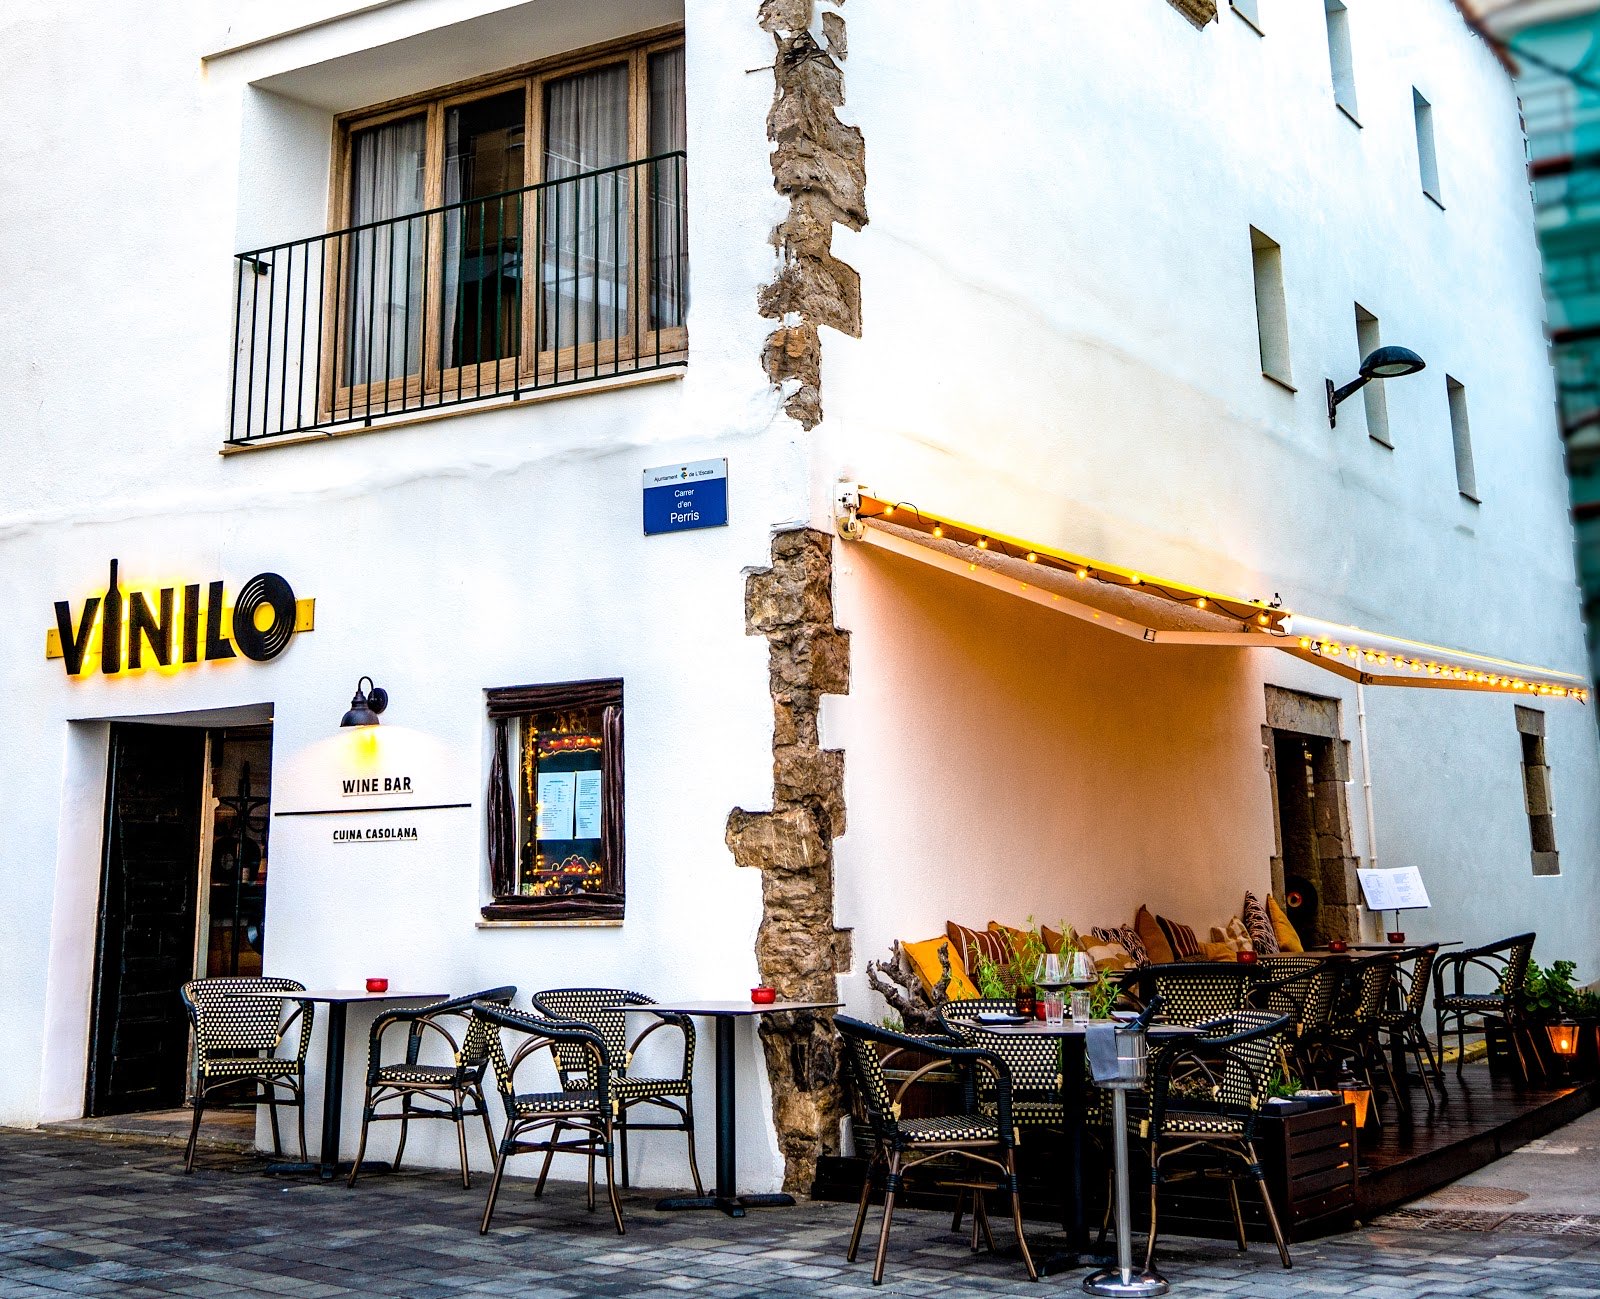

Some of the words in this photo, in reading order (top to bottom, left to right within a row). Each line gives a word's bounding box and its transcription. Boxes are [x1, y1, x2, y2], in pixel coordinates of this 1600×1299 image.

[654, 474, 678, 483] Ajuntament
[674, 489, 695, 498] Carrer
[677, 500, 692, 509] d'en
[670, 509, 700, 524] Perris
[53, 558, 297, 676] VINILO
[342, 778, 379, 793] WINE
[384, 776, 411, 791] BAR
[333, 829, 362, 840] CUINA
[365, 827, 418, 839] CASOLANA
